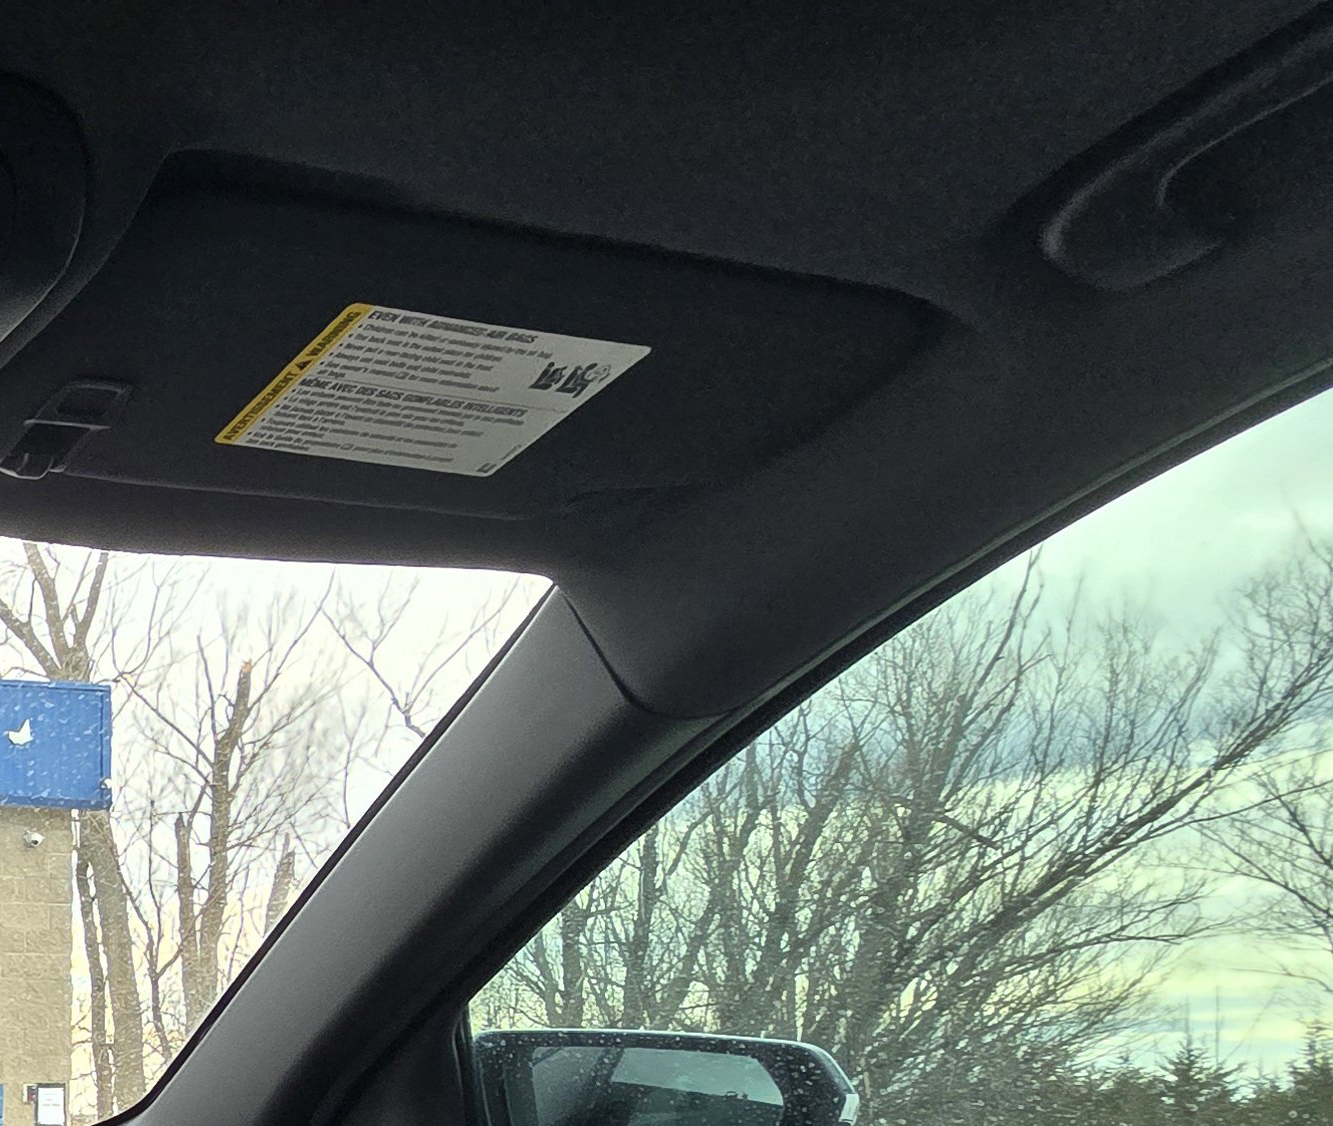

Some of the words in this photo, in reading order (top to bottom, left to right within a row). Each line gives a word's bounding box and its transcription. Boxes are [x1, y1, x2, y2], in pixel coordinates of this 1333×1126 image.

[329, 382, 357, 393] AVEC
[355, 386, 377, 397] DES
[375, 389, 404, 400] SACS
